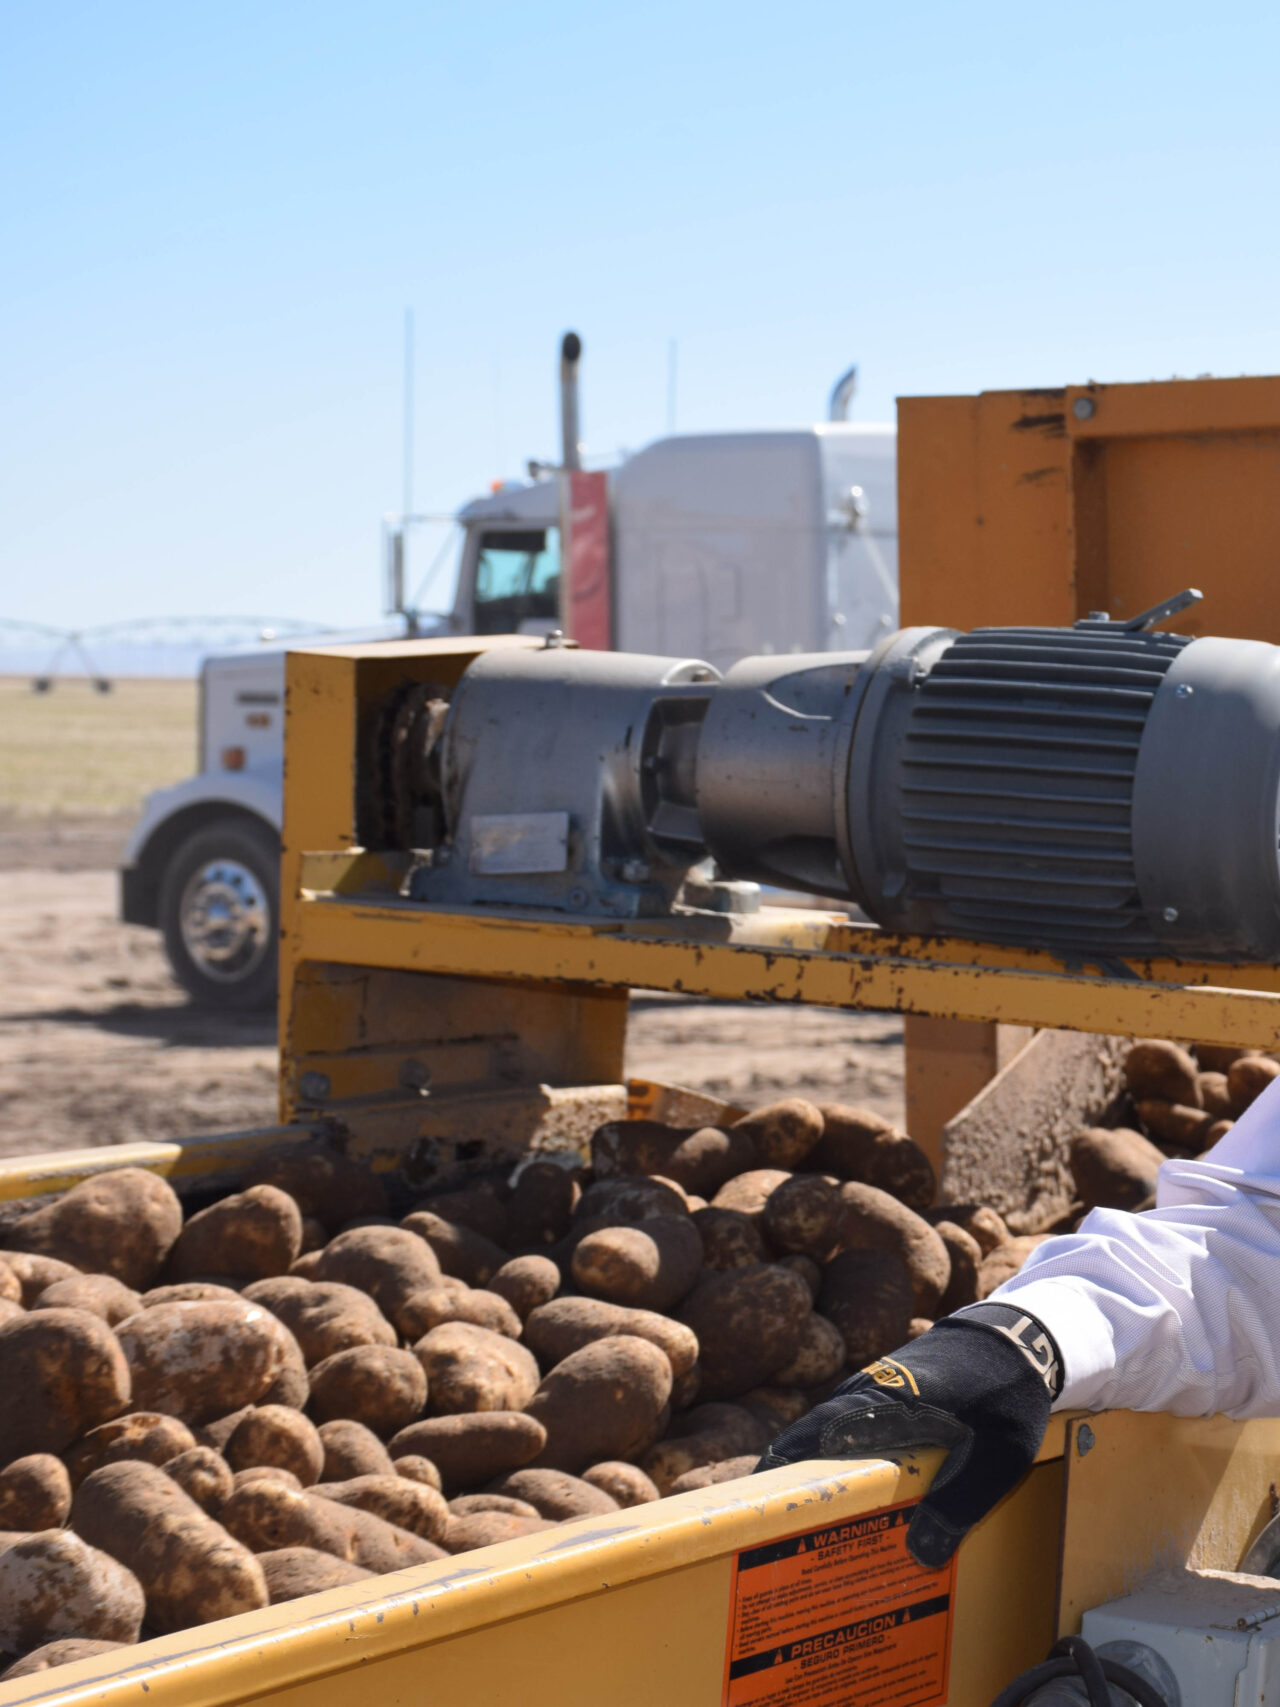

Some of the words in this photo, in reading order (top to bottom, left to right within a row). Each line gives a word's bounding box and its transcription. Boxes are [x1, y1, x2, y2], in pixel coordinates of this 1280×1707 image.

[813, 1516, 889, 1548] WARNING
[817, 1543, 853, 1560] SAFETY
[857, 1533, 883, 1548] FIRST
[790, 1613, 895, 1659] PRECAUCION
[800, 1648, 839, 1669] SEGURO
[843, 1633, 884, 1655] PRIMERO
